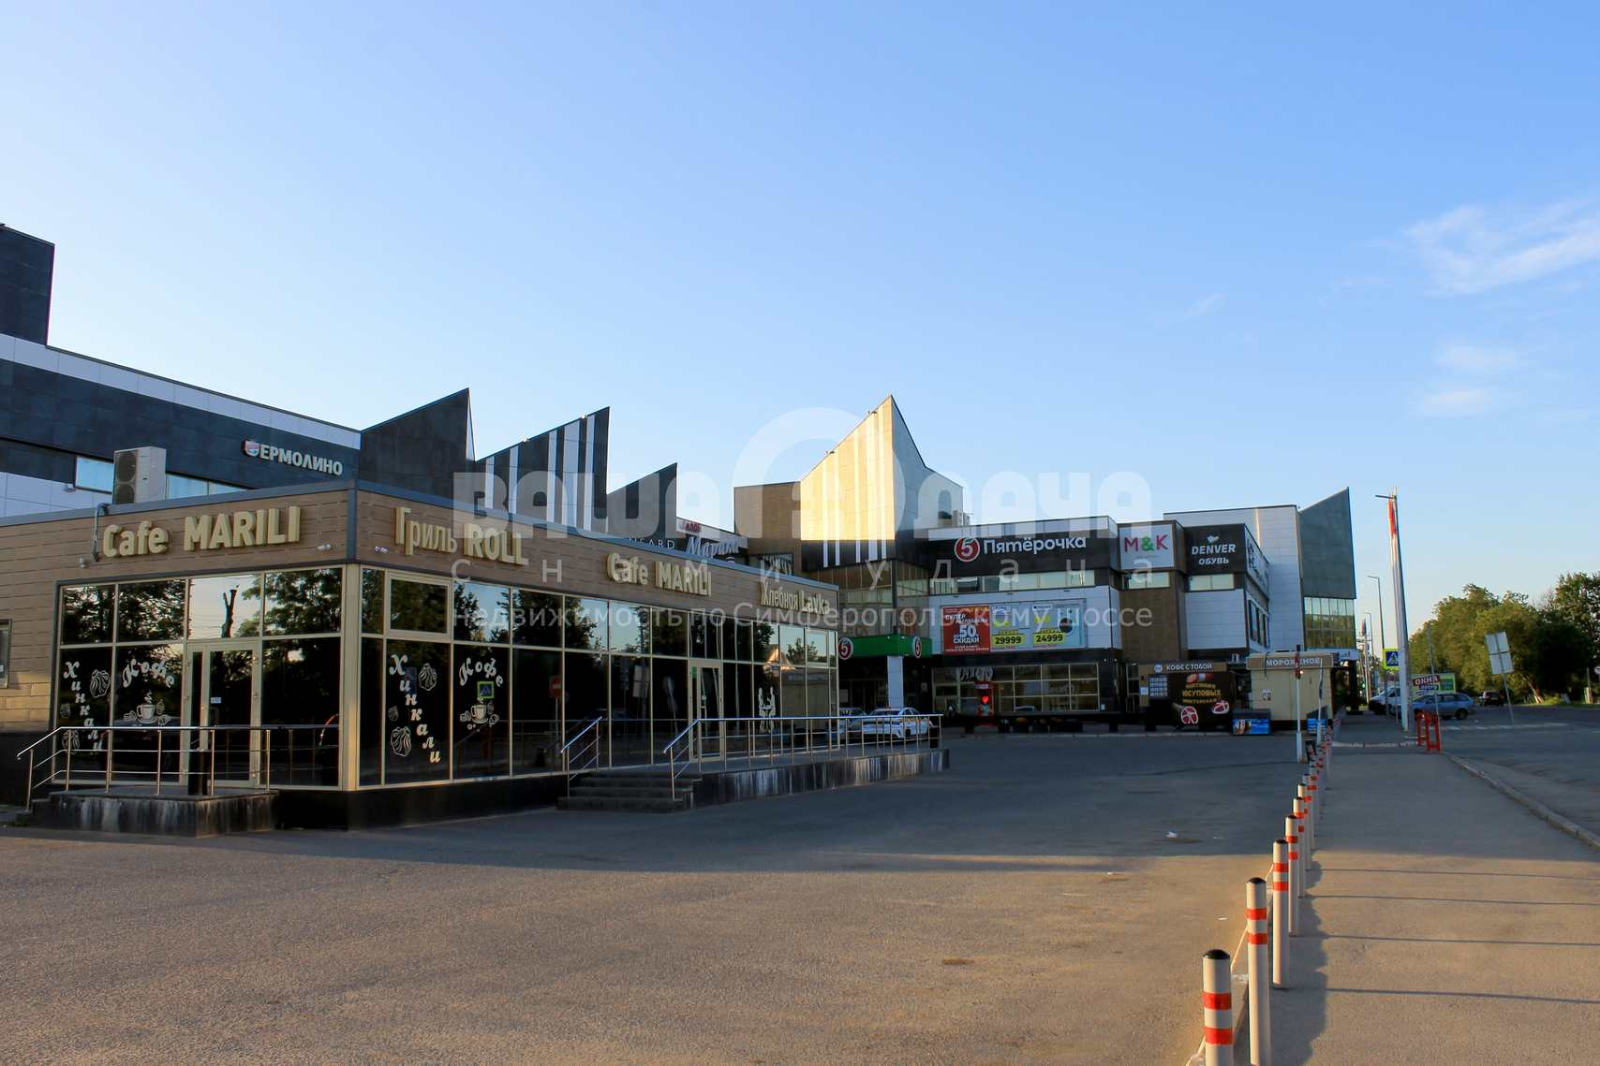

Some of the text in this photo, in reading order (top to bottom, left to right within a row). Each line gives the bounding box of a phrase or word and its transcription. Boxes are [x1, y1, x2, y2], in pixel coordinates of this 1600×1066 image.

[102, 506, 301, 558] Cafe MARILI
[395, 506, 529, 567] Гриль ROLL
[983, 536, 1087, 556] Пятёрочка
[1123, 534, 1168, 553] M&K
[1191, 543, 1236, 555] DENVER
[1198, 556, 1229, 566] ОБУВЬ
[606, 552, 649, 586] Cafe
[760, 580, 830, 615] Хлебная Lavka
[994, 636, 1022, 645] 29999
[1035, 634, 1064, 643] 24999
[122, 658, 175, 688] Кофе
[459, 657, 504, 687] Кофе
[388, 654, 441, 763] Хинкали
